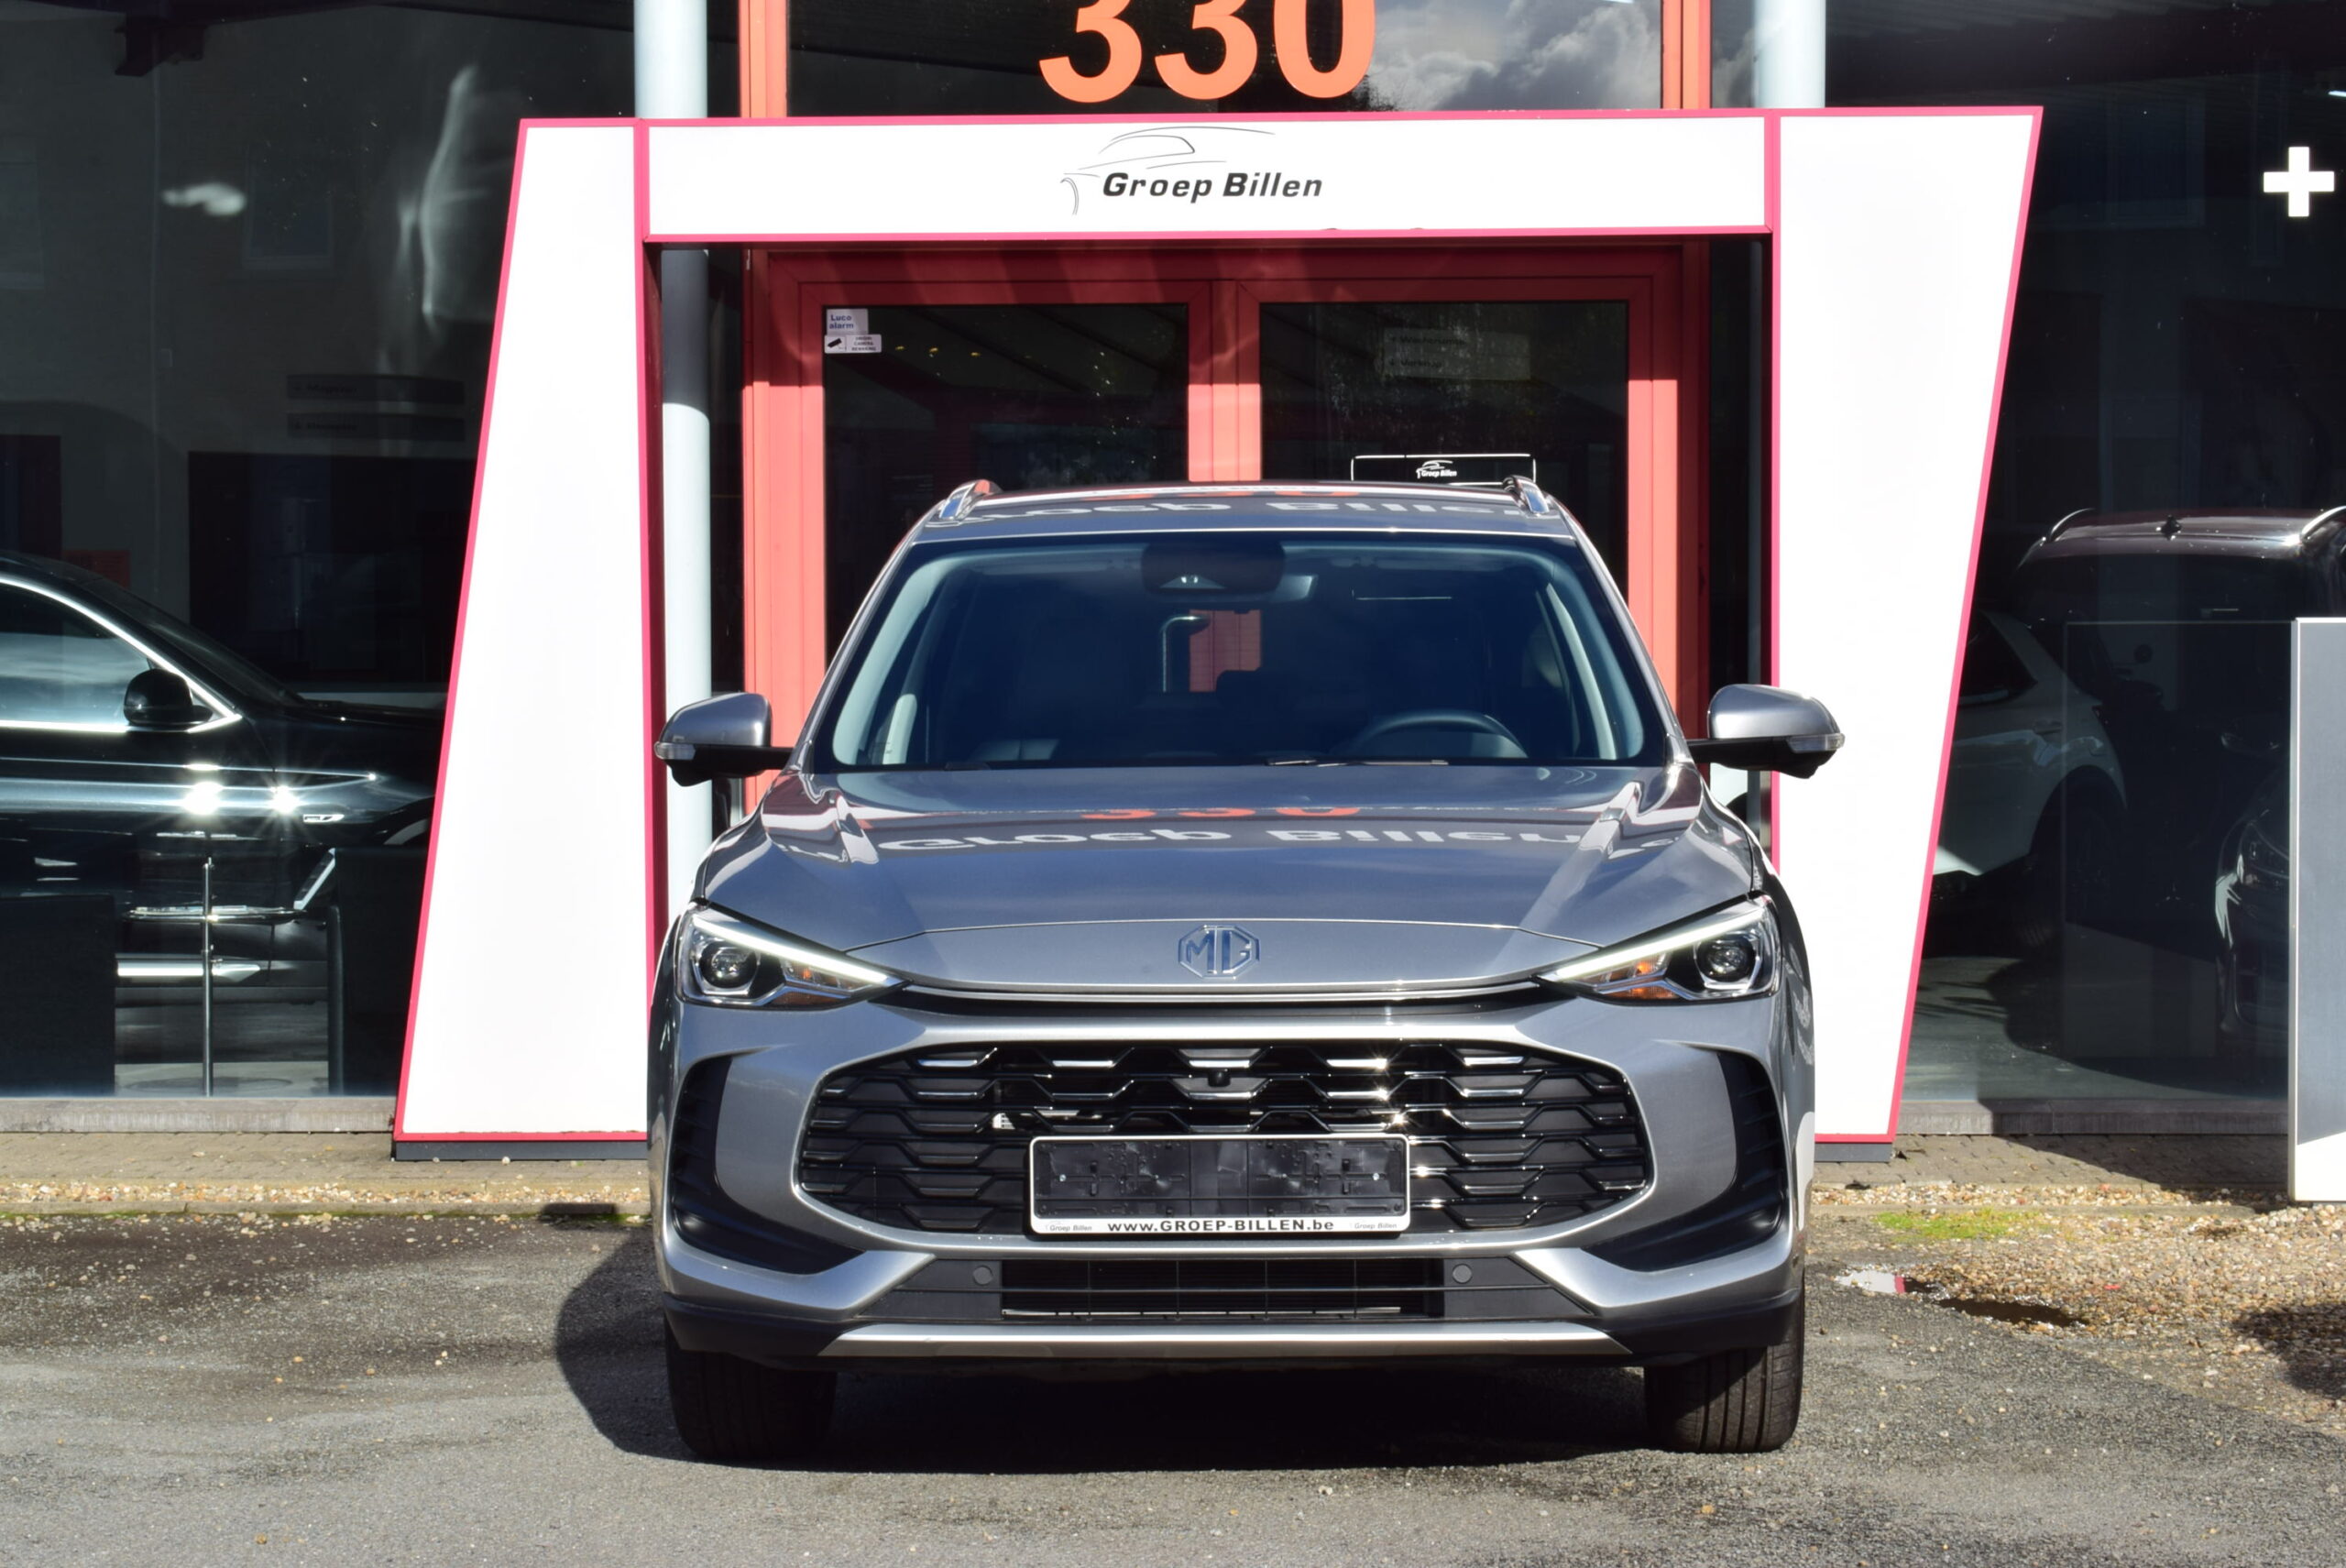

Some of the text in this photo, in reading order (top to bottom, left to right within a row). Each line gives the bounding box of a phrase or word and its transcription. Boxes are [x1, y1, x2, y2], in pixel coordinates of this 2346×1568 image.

[1038, 0, 1376, 103] 330
[1102, 172, 1322, 203] Groep Billen
[1183, 927, 1254, 975] MG
[1073, 1223, 1093, 1232] Billen
[1107, 1219, 1334, 1232] www.GROEP-BILLEN.be
